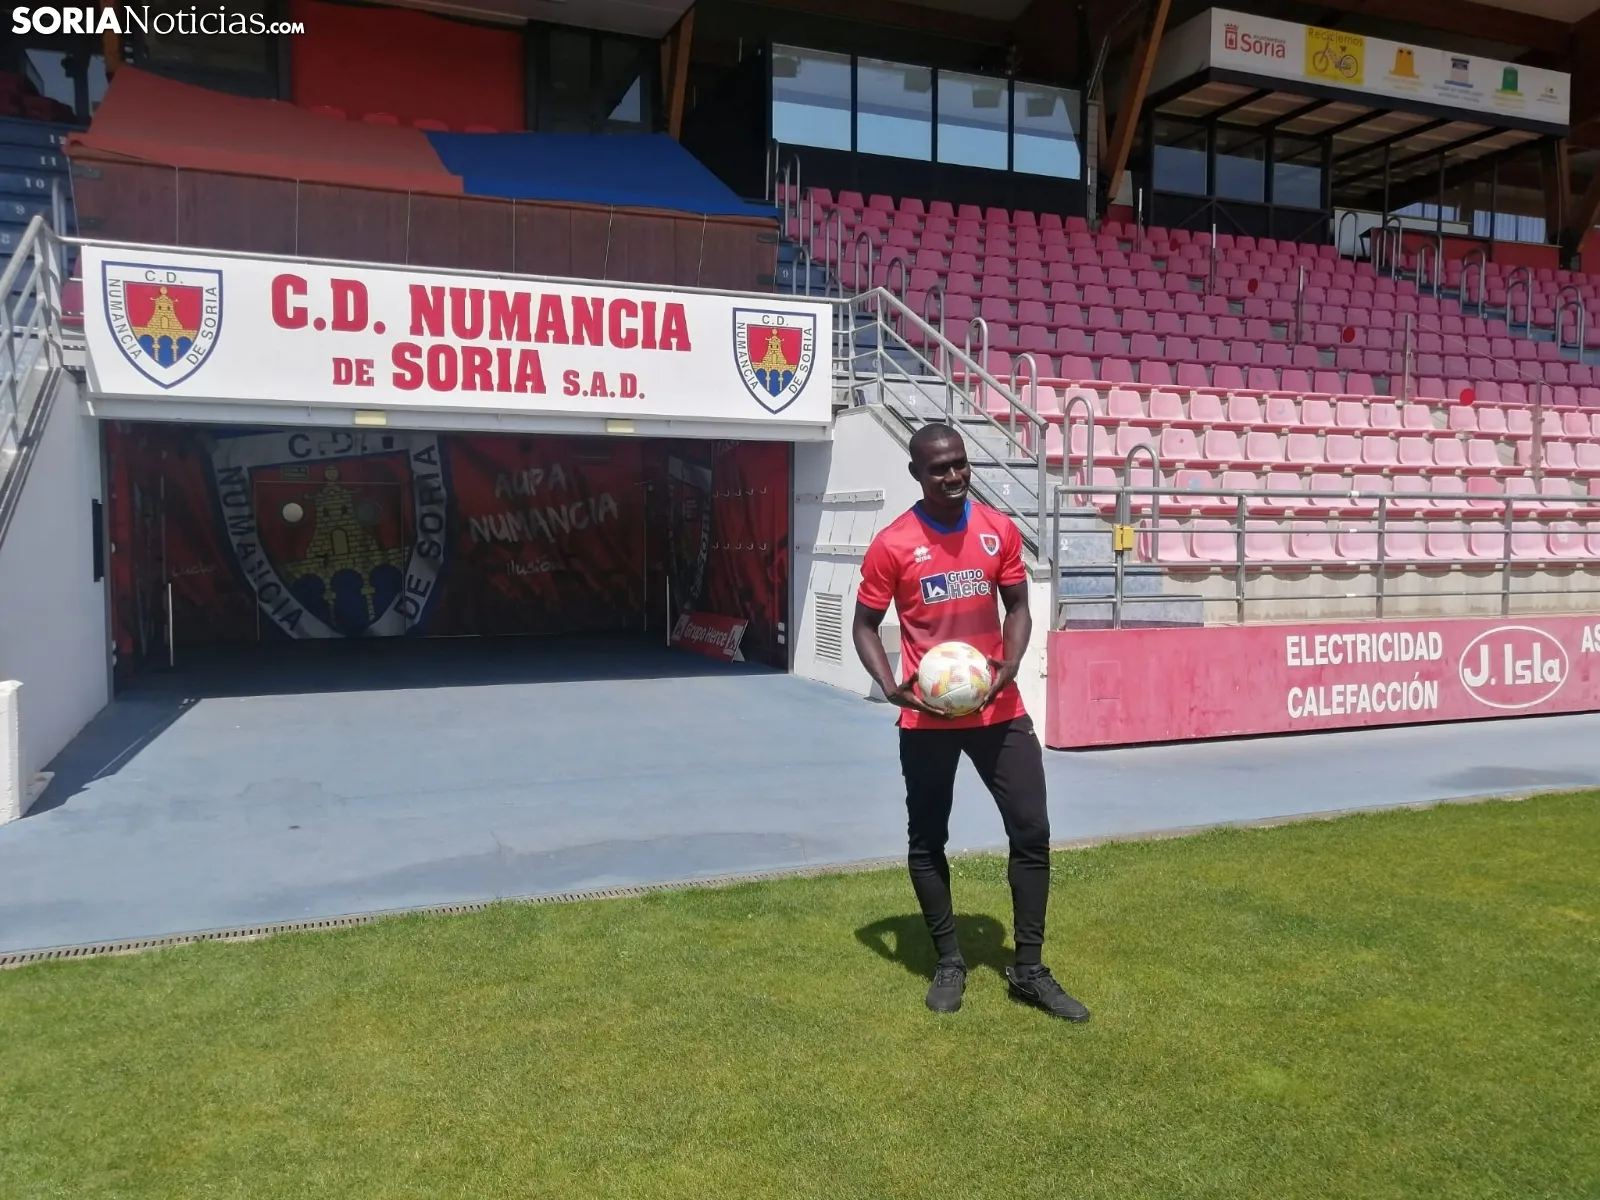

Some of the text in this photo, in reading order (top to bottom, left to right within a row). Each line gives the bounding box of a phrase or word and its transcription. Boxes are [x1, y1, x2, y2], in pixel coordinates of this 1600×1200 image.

[1240, 33, 1286, 59] Soria
[25, 177, 45, 189] 10
[15, 204, 26, 215] 9
[145, 269, 184, 285] C.D.
[782, 269, 789, 279] 9
[108, 278, 142, 360] NUMANCIA
[186, 287, 218, 365] DE SORIA
[271, 273, 692, 352] C.D. NUMANCIA
[761, 314, 789, 326] C.D.
[332, 341, 646, 400] DE SORIA S.A.D.
[736, 322, 759, 390] NUMANCIA
[788, 327, 812, 394] DE SORIA
[495, 462, 568, 499] AUPA
[393, 444, 446, 621] DE SORIA
[469, 492, 619, 543] NUMANCIA
[217, 465, 303, 632] NUMANCIA
[1060, 538, 1069, 551] 2
[684, 622, 728, 647] Grupo Herce
[1286, 631, 1443, 667] ELECTRICIDAD
[1463, 642, 1561, 687] J. Isla
[1287, 672, 1438, 718] CALEFACCIÓN
